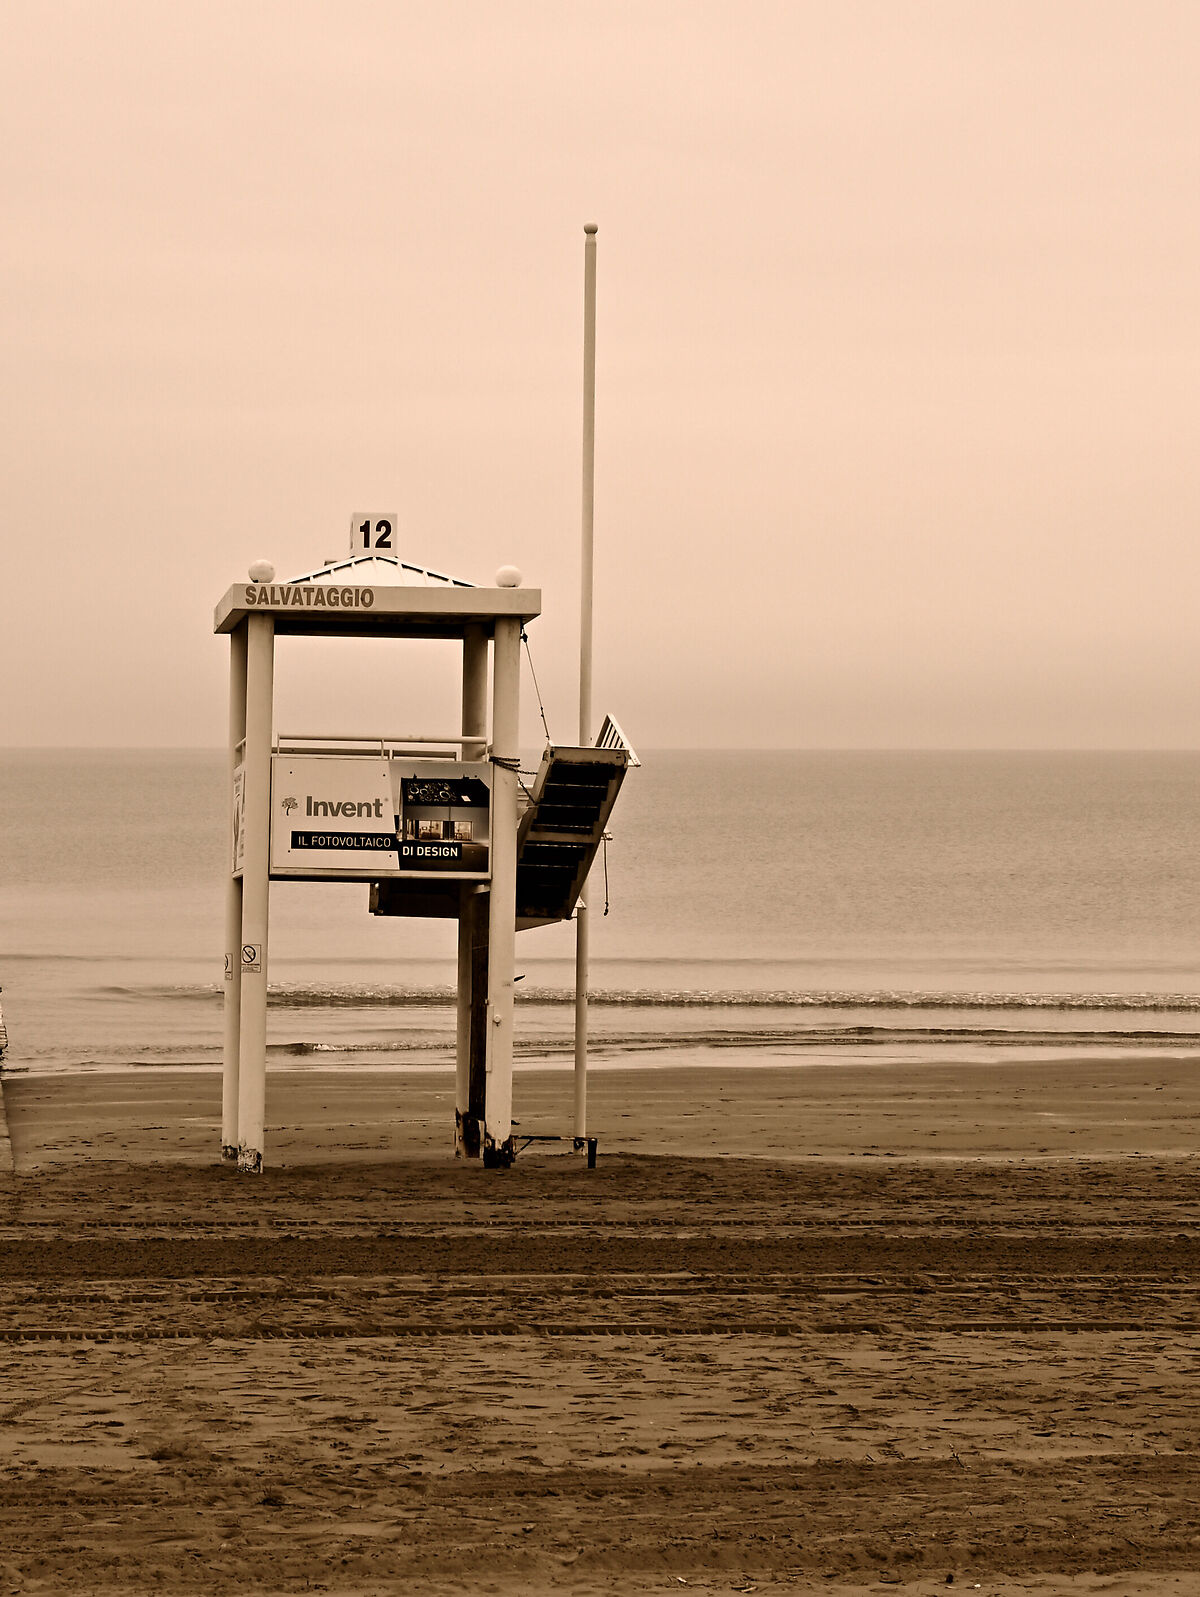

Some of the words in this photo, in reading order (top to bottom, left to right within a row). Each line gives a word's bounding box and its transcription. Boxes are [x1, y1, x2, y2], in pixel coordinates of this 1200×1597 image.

[359, 519, 392, 549] 12
[245, 585, 375, 608] SALVATAGGIO
[306, 795, 383, 818] Invent
[298, 835, 309, 846] IL
[311, 835, 391, 848] FOTOVOLTAICO
[402, 846, 414, 857] DI
[416, 846, 459, 857] DESIGN
